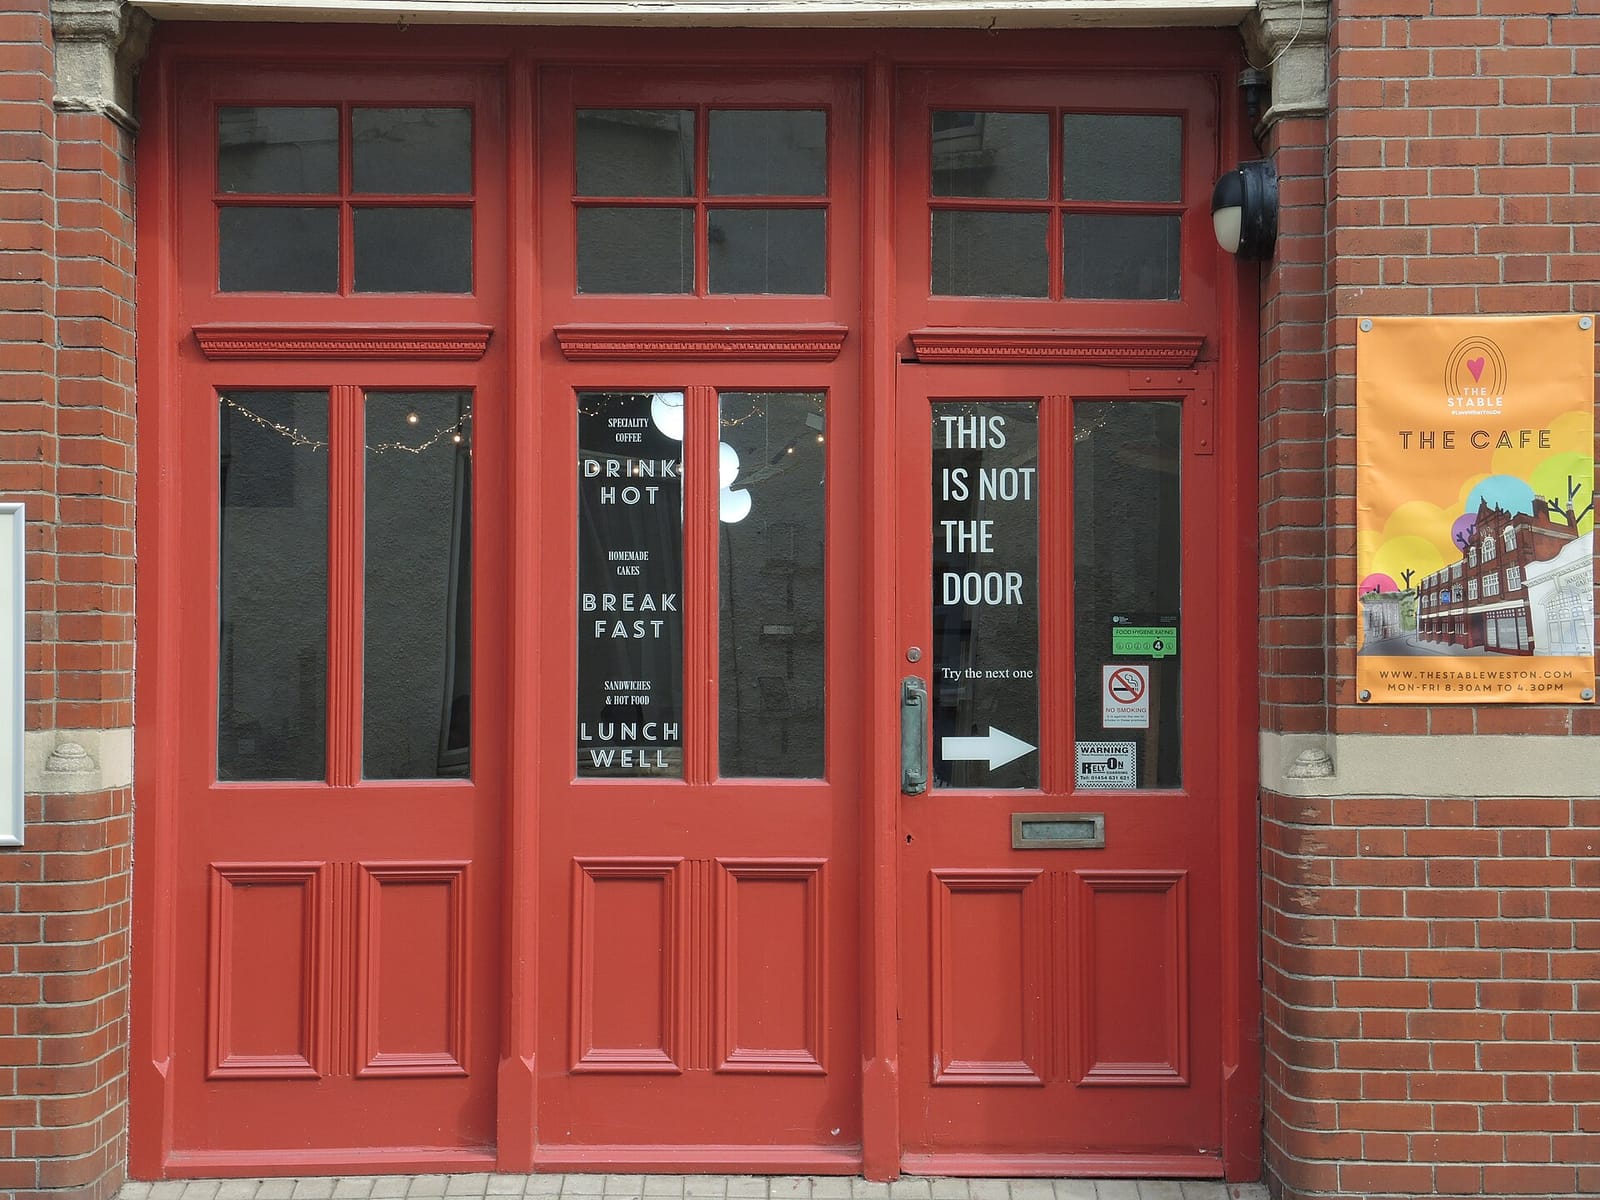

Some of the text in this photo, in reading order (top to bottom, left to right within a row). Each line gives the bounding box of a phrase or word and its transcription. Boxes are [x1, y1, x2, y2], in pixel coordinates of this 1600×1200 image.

[1463, 387, 1487, 396] THE
[1447, 397, 1503, 407] STABLE
[608, 418, 649, 428] SPECIALITY
[615, 432, 642, 443] COFFEE
[940, 415, 1006, 449] THIS
[1399, 430, 1552, 450] THE CAFE
[584, 459, 677, 478] DRINK
[942, 467, 1036, 501] IS NOT
[600, 486, 659, 505] HOT
[940, 520, 994, 553] THE
[608, 551, 649, 561] HOMEMADE
[617, 566, 640, 576] CAKES
[943, 572, 1023, 606] DOOR
[582, 593, 677, 612] BREAK
[595, 620, 664, 639] FAST
[1154, 641, 1162, 650] 4
[942, 667, 1033, 681] Try the next one
[1380, 671, 1573, 679] WWW.THESTABLEWESTON.COM
[604, 680, 651, 691] SANDWICHES
[1388, 683, 1564, 692] MON-FRI 8.30AM TO 4.30PM
[605, 695, 650, 705] & HOT FOOD
[580, 722, 678, 741] LUNCH
[590, 749, 669, 768] WELL
